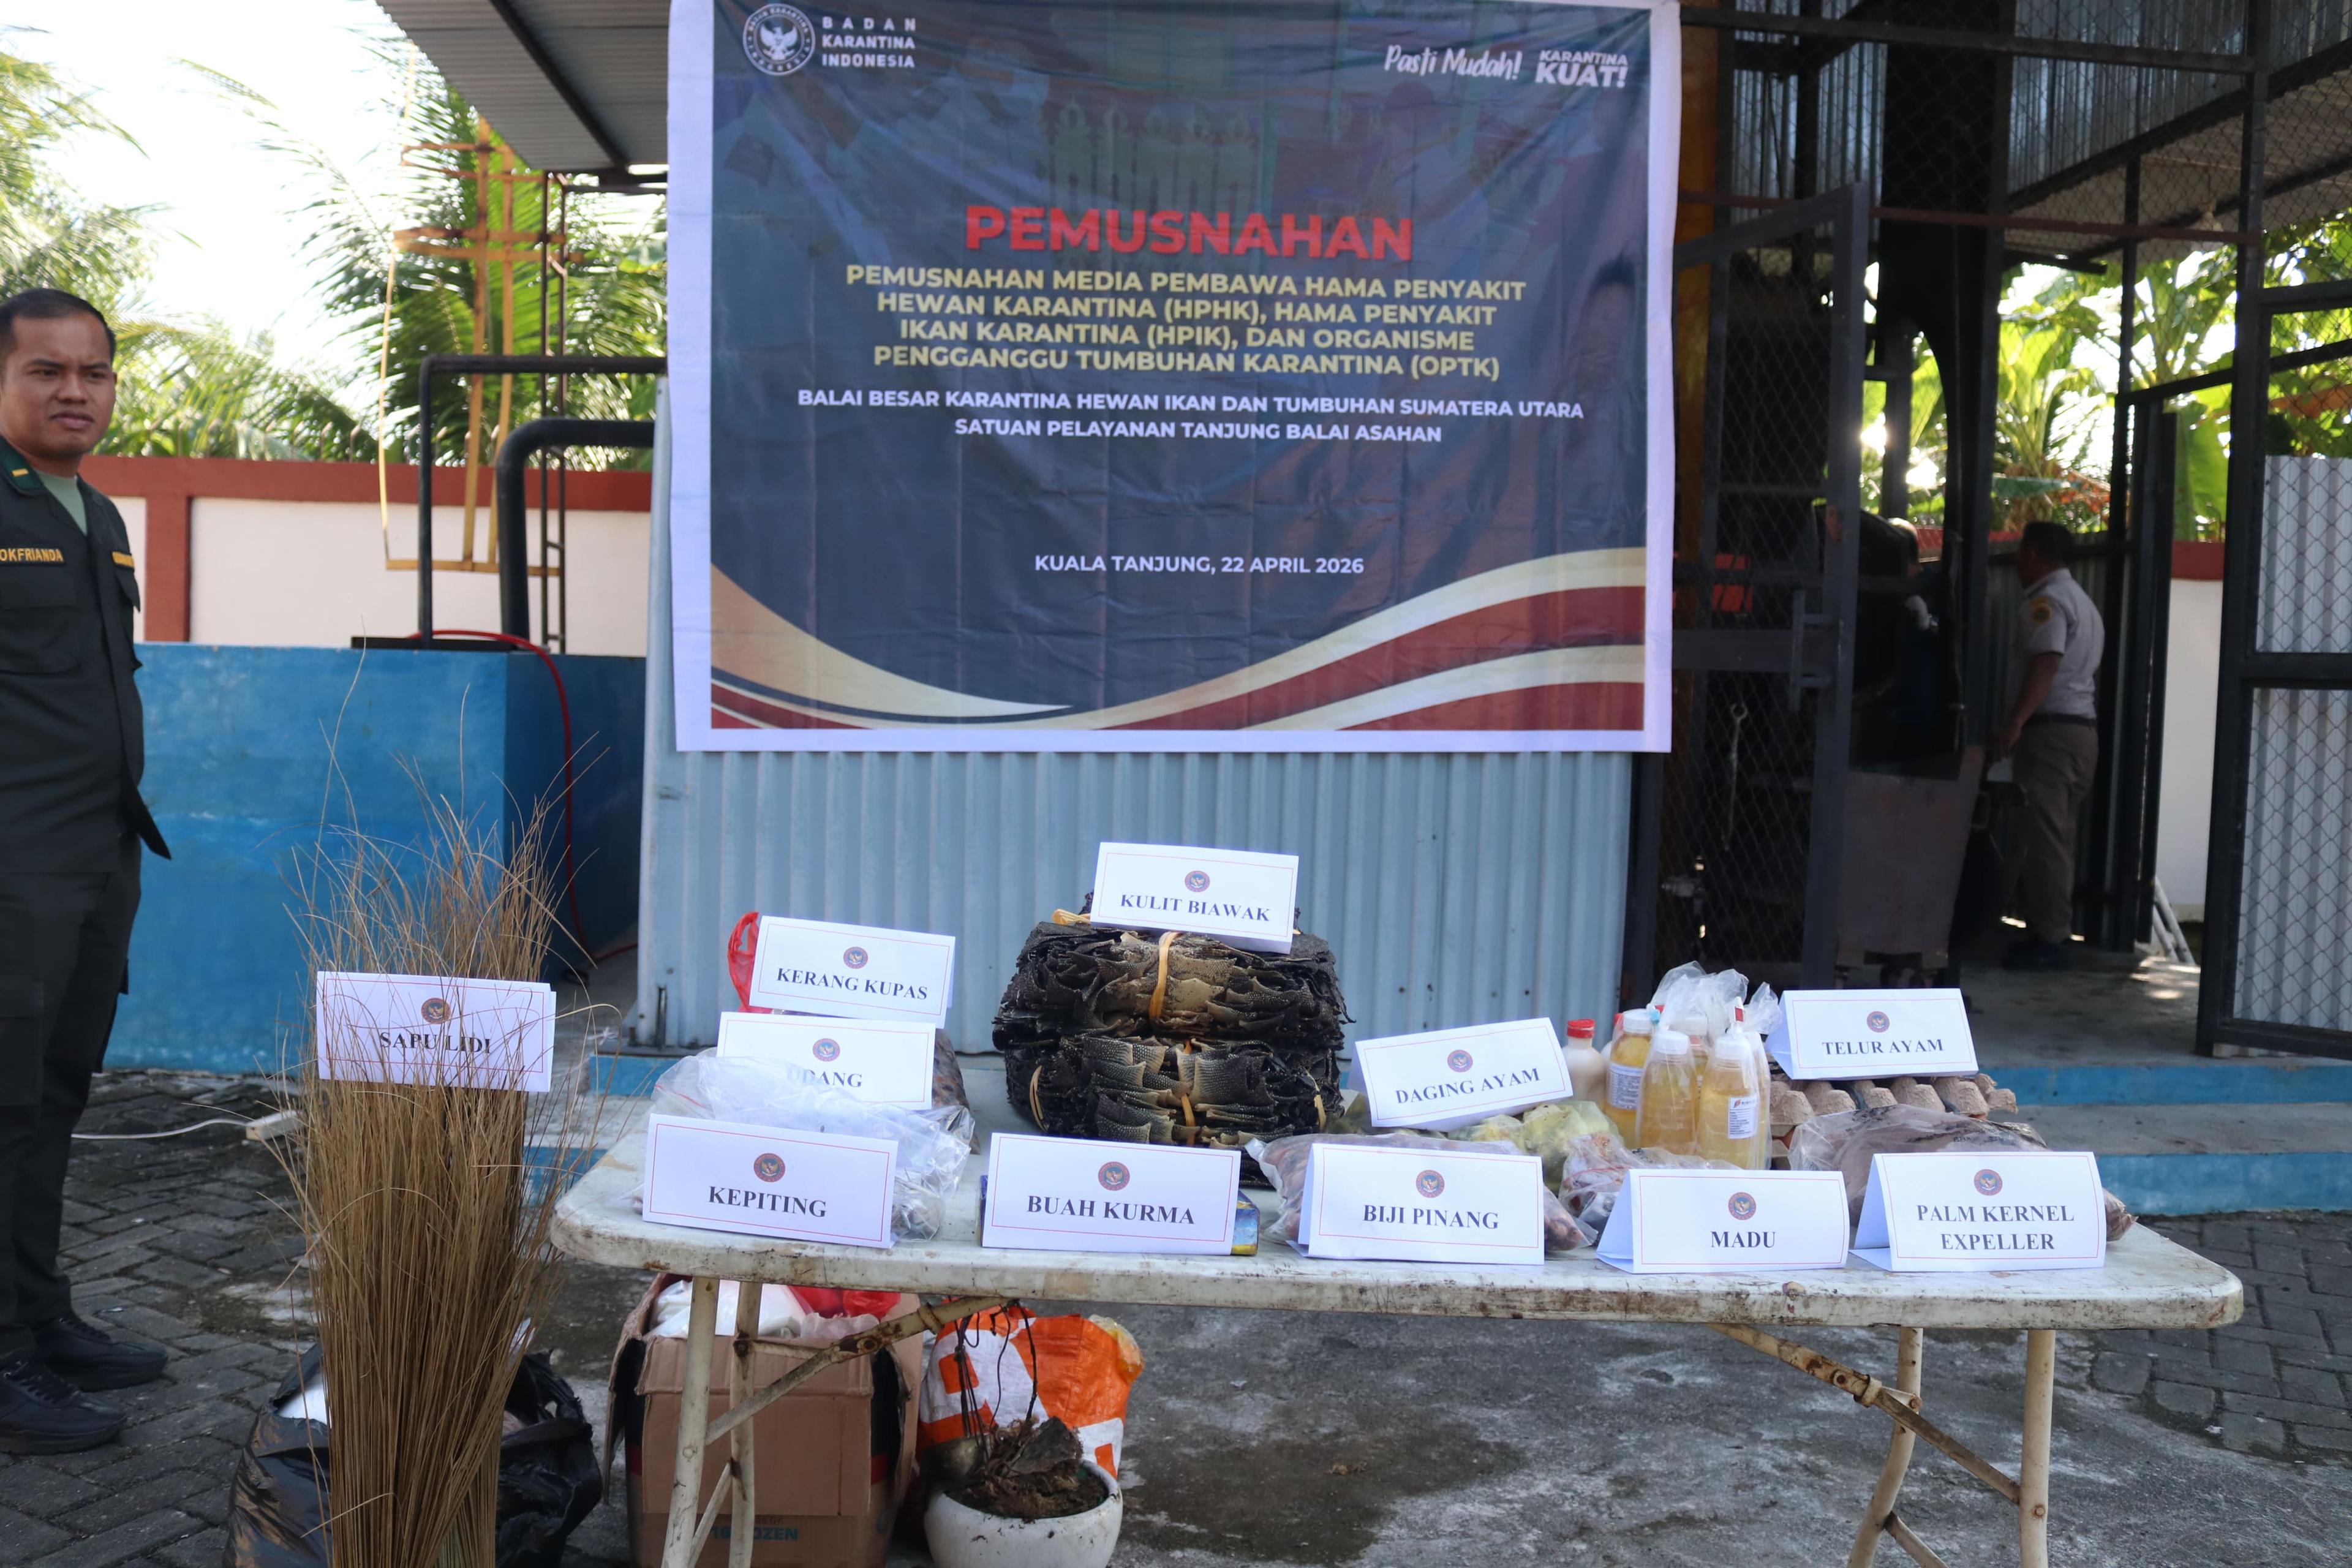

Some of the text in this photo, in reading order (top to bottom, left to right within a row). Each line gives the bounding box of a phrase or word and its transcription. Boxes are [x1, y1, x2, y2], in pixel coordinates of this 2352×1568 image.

[822, 17, 916, 31] BADAN
[822, 34, 915, 49] KARANTINA
[822, 53, 914, 68] INDONESIA
[1384, 45, 1523, 81] Pasti Mudah!
[1539, 50, 1628, 66] KARANTINA
[1535, 62, 1628, 88] KUAT!
[967, 206, 1412, 258] PEMUSNAHAN
[847, 265, 1526, 300] PEMUSNAHAN MEDIA PEMBAWA HAMA PENYAKIT
[878, 292, 1497, 325] HEWAN KARANTINA (HPHK), HAMA PENYAKIT
[901, 319, 1474, 350] IKAN KARANTINA (HPIK), DAN ORGANISME
[875, 346, 1499, 382] PENGGANGGU TUMBUHAN KARANTINA (OPTK)
[798, 390, 1583, 418] BALAI BESAR KARANTINA HEWAN IKAN DAN TUMBUHAN SUMATERA UTARA
[956, 419, 1441, 442] SATUAN PELAYANAN TANJUNG BALAI ASAHAN
[1036, 556, 1364, 575] KUALA TANJUNG, 22 APRIL 2026
[1121, 895, 1269, 921] KULIT BIAWAK
[777, 968, 927, 1000] KERANG KUPAS
[380, 1031, 491, 1054] SAPU LIDI
[1822, 1039, 1943, 1054] TELUR AYAM
[1396, 1068, 1539, 1103] DAGING AYAM
[709, 1186, 826, 1217] KEPITING
[1028, 1196, 1194, 1224] BUAH KURMA
[1918, 1205, 2074, 1222] PALM KERNEL
[1363, 1205, 1498, 1229] BIJI PINANG
[1711, 1232, 1774, 1248] MADU
[1942, 1234, 2054, 1250] EXPELLER
